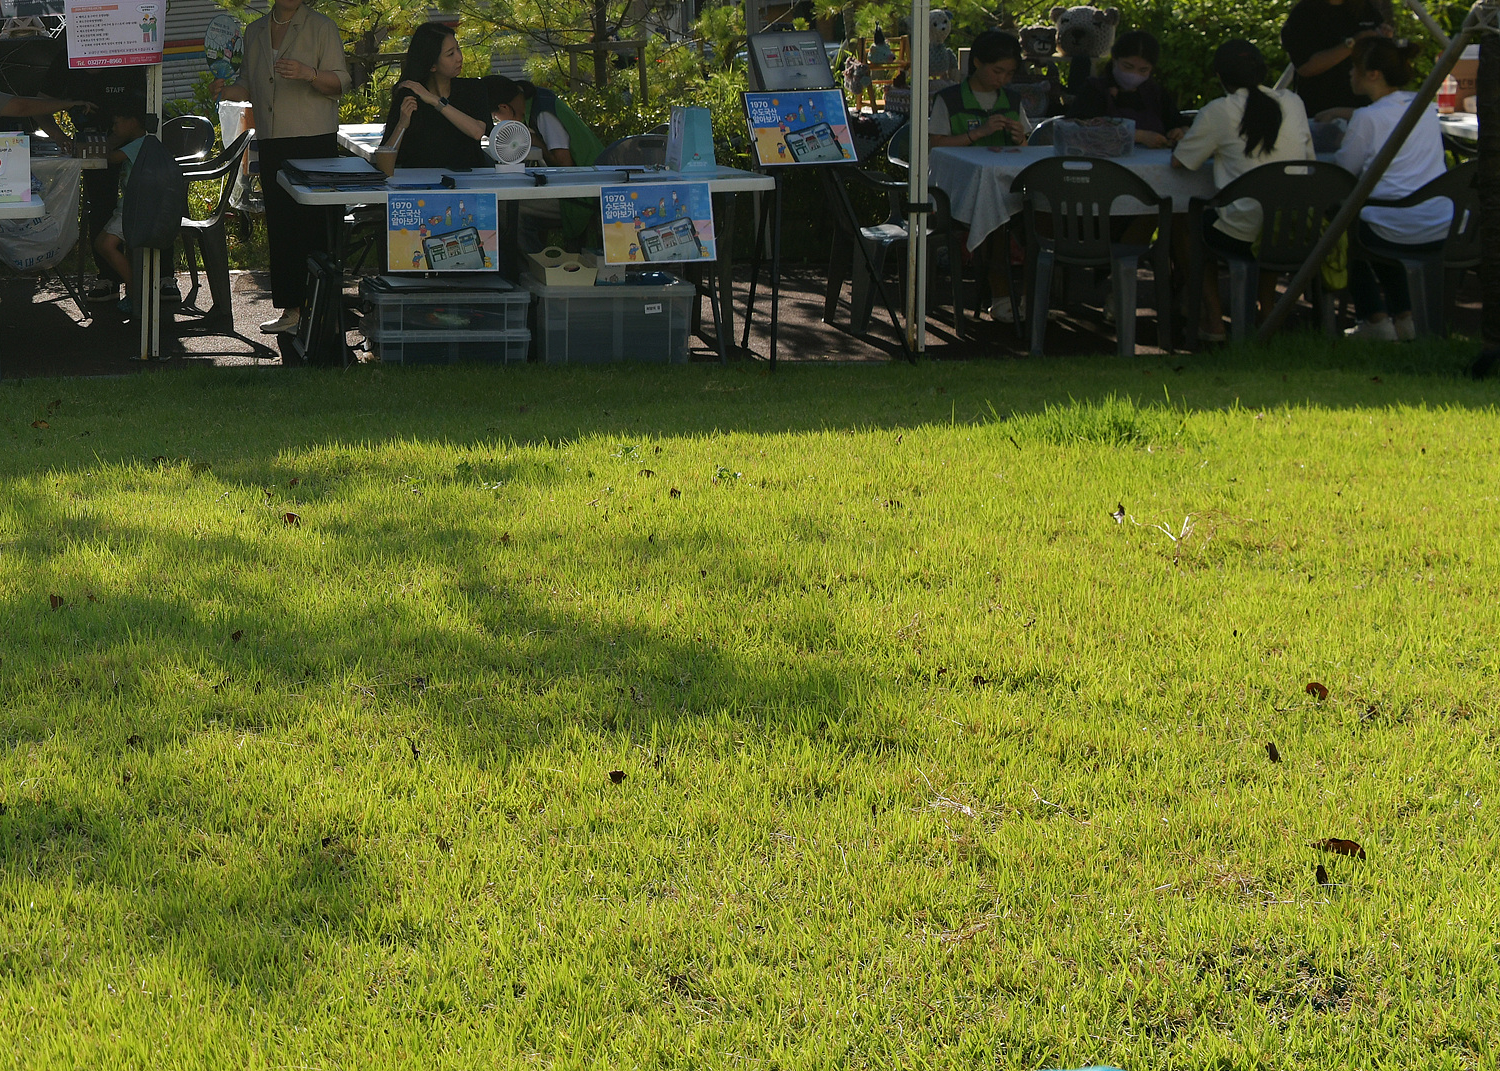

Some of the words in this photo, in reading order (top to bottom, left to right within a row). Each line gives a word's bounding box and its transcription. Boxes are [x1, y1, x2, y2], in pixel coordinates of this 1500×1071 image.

[105, 86, 125, 94] STAFF
[750, 101, 769, 109] 1970
[751, 108, 777, 116] 수도국산
[604, 195, 625, 203] 1970
[605, 202, 634, 210] 수도국산
[391, 209, 422, 218] 수도국산
